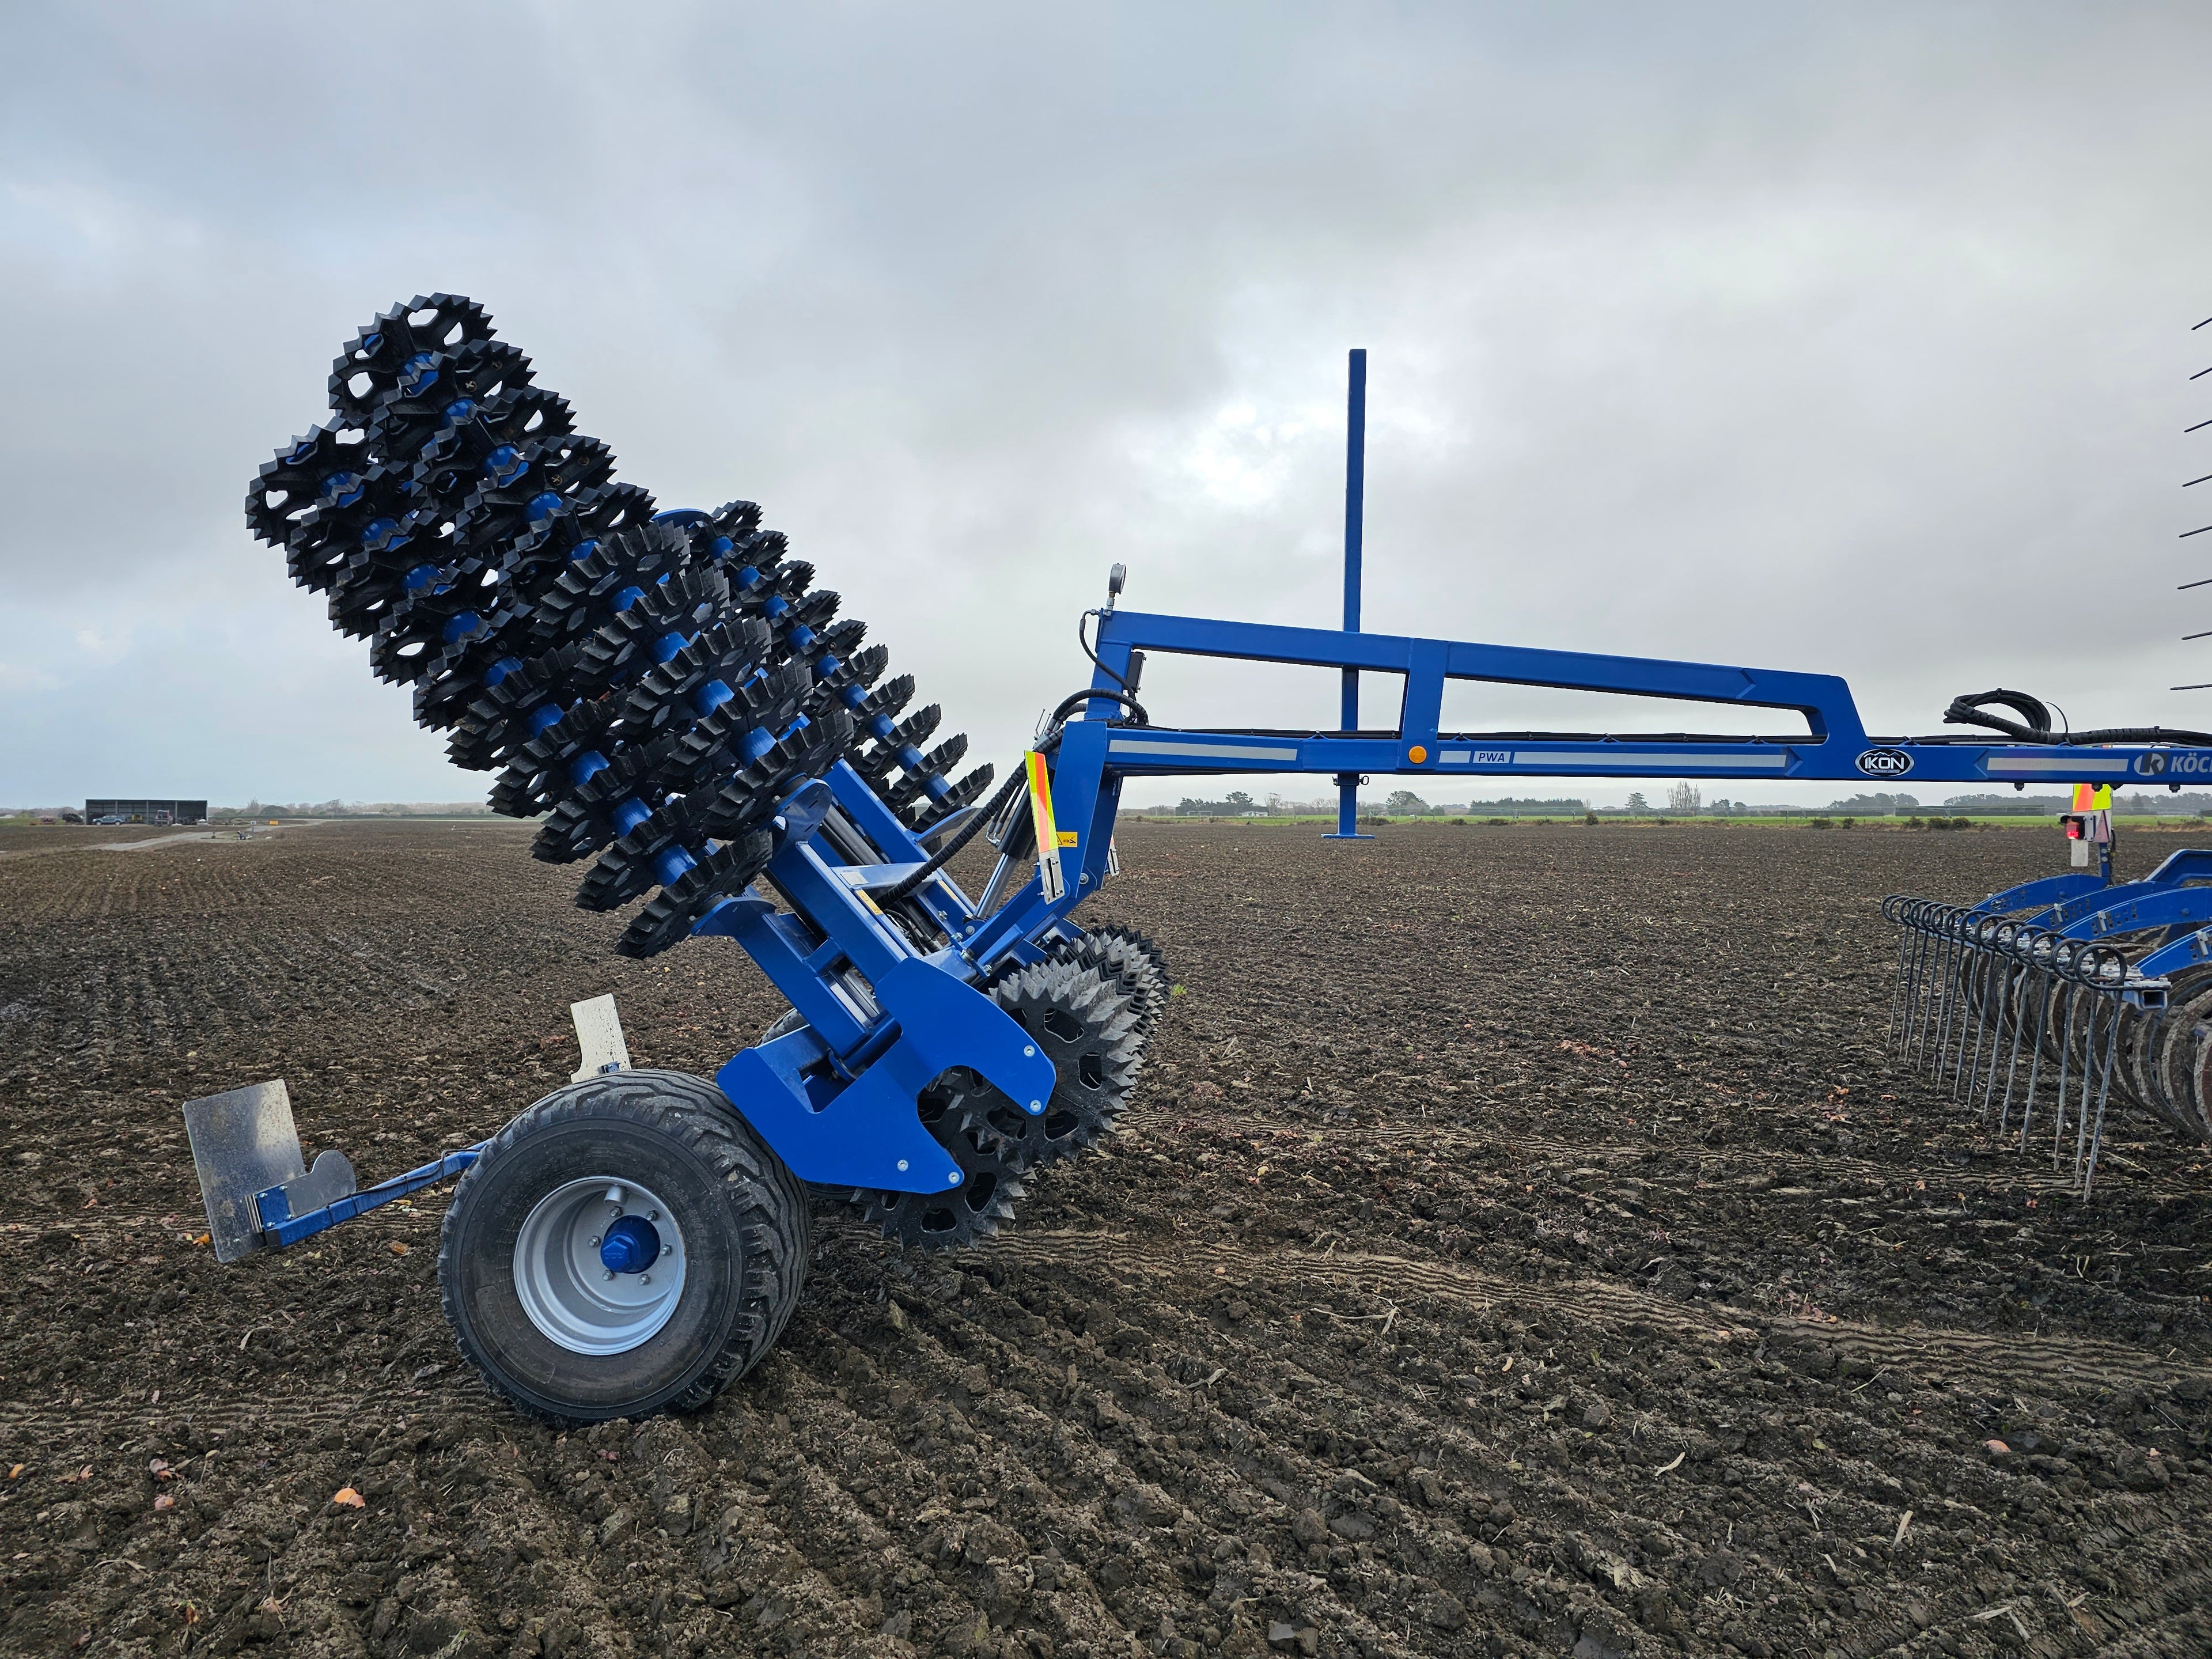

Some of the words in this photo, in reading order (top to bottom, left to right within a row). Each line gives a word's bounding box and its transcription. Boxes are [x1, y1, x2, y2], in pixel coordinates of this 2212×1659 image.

[1478, 752, 1505, 762] PWA
[1865, 757, 1904, 769] IKON
[2171, 752, 2212, 772] KÖC
